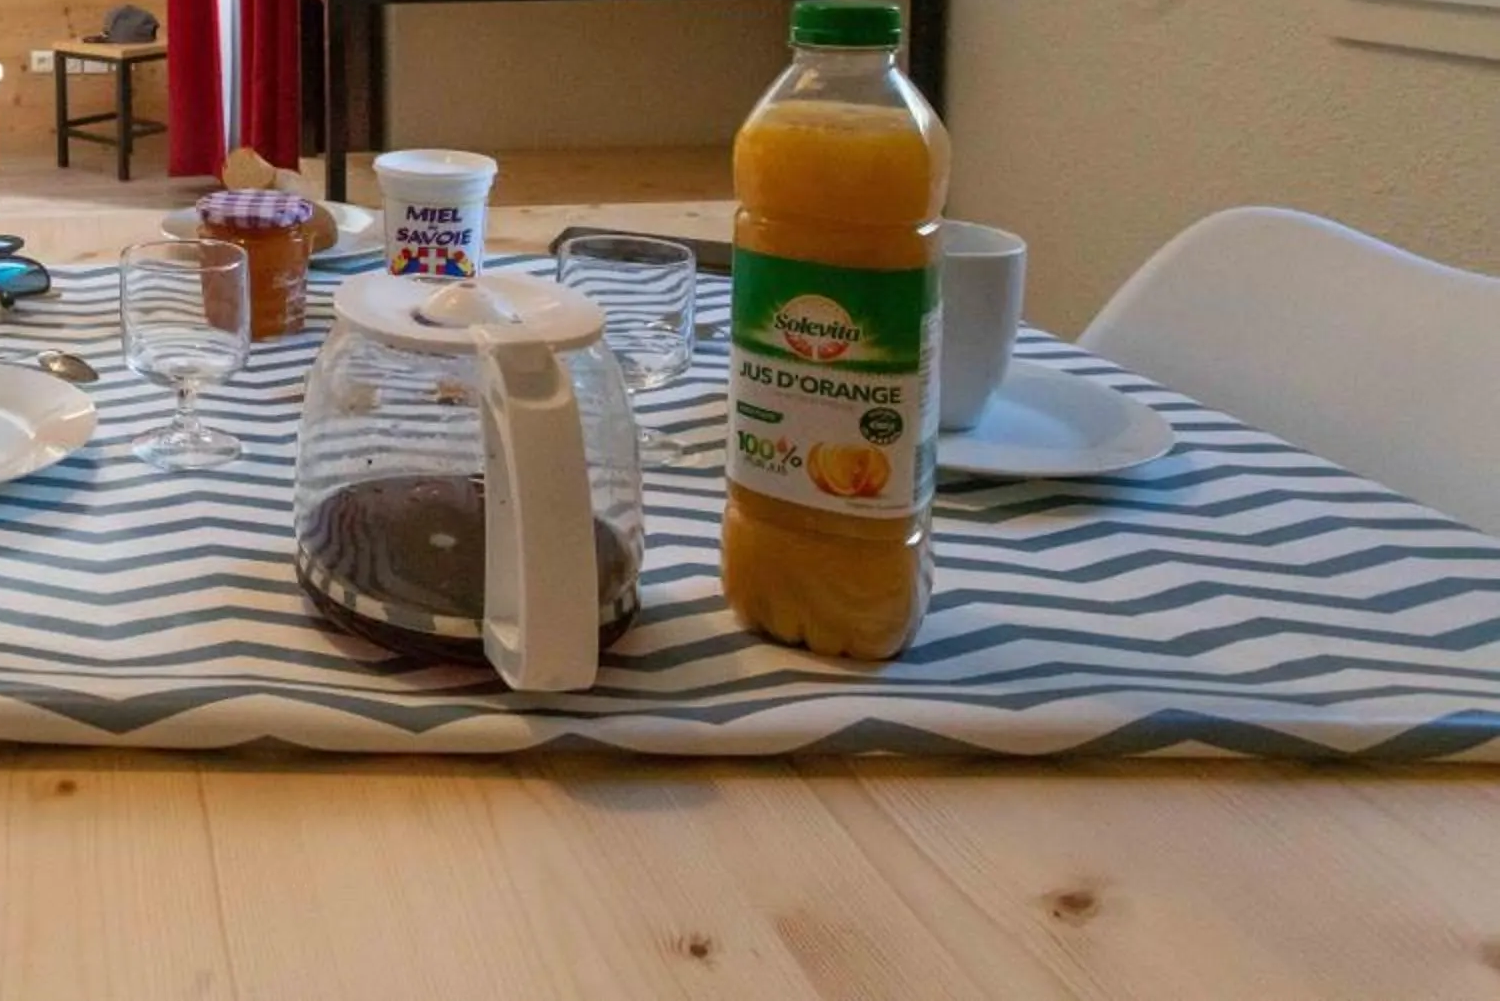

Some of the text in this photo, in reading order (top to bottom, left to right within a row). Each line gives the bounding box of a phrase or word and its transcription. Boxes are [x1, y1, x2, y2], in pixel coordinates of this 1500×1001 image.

[406, 205, 462, 223] MIEL
[396, 227, 472, 246] SAVOIE
[774, 313, 860, 341] Solevita
[739, 362, 773, 385] JUS
[777, 370, 901, 403] D'ORANGE
[737, 430, 802, 468] 100%
